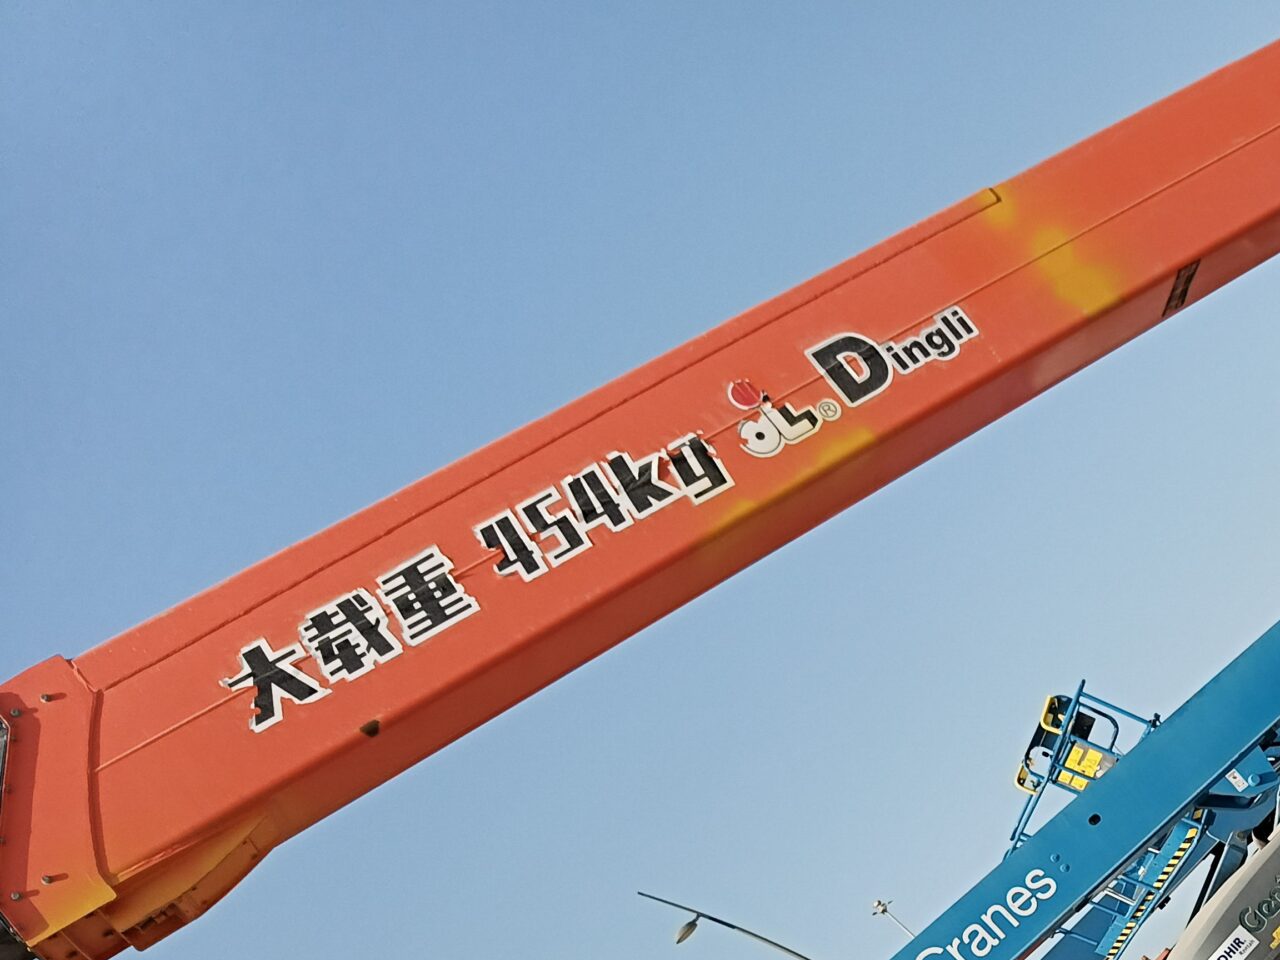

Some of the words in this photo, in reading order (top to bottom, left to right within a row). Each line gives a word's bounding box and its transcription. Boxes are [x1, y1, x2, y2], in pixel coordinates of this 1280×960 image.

[807, 306, 978, 405] Dingli
[222, 549, 476, 730] 大载重
[475, 434, 732, 580] 454kg
